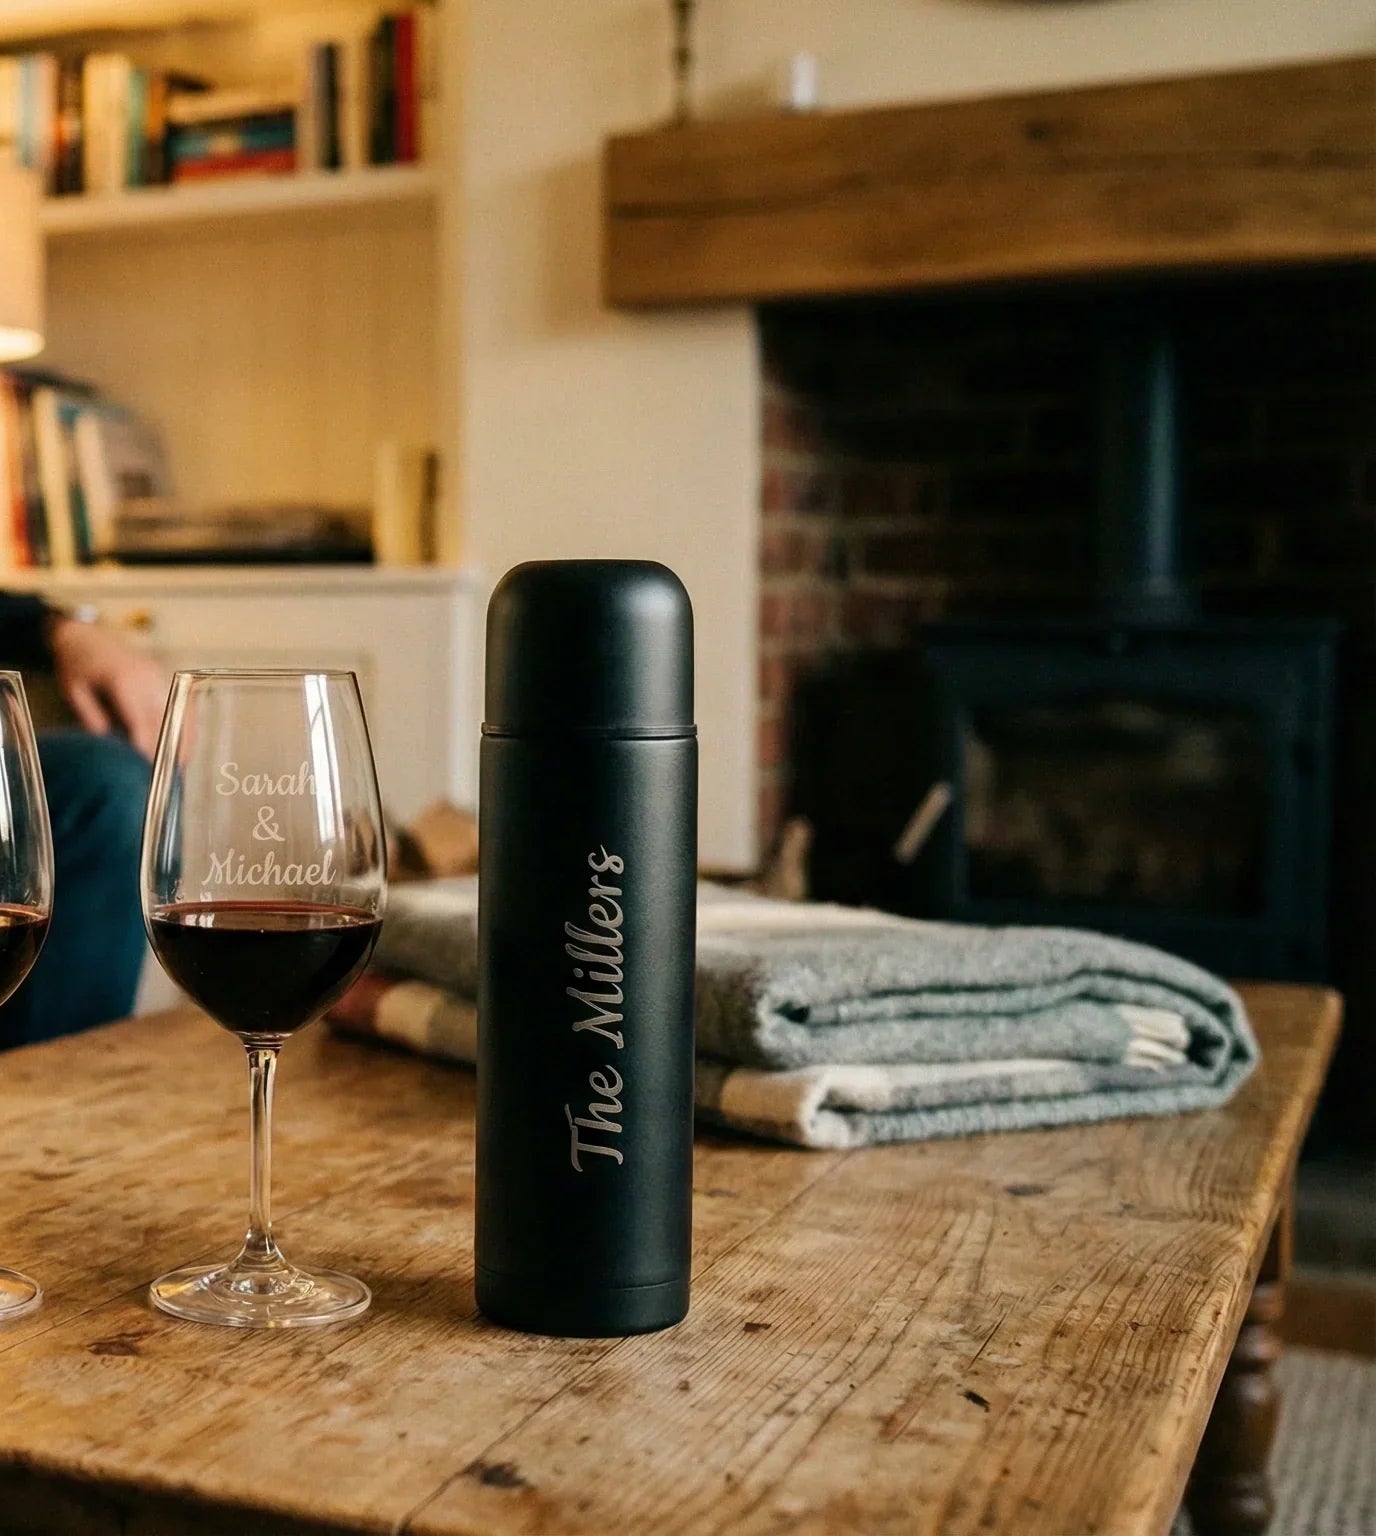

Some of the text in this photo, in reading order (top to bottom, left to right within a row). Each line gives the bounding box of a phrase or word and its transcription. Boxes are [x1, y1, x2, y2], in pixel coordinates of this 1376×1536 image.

[215, 761, 317, 796] Sarah
[252, 805, 285, 842] &
[201, 848, 336, 886] Michael
[564, 844, 624, 1172] The Millers
